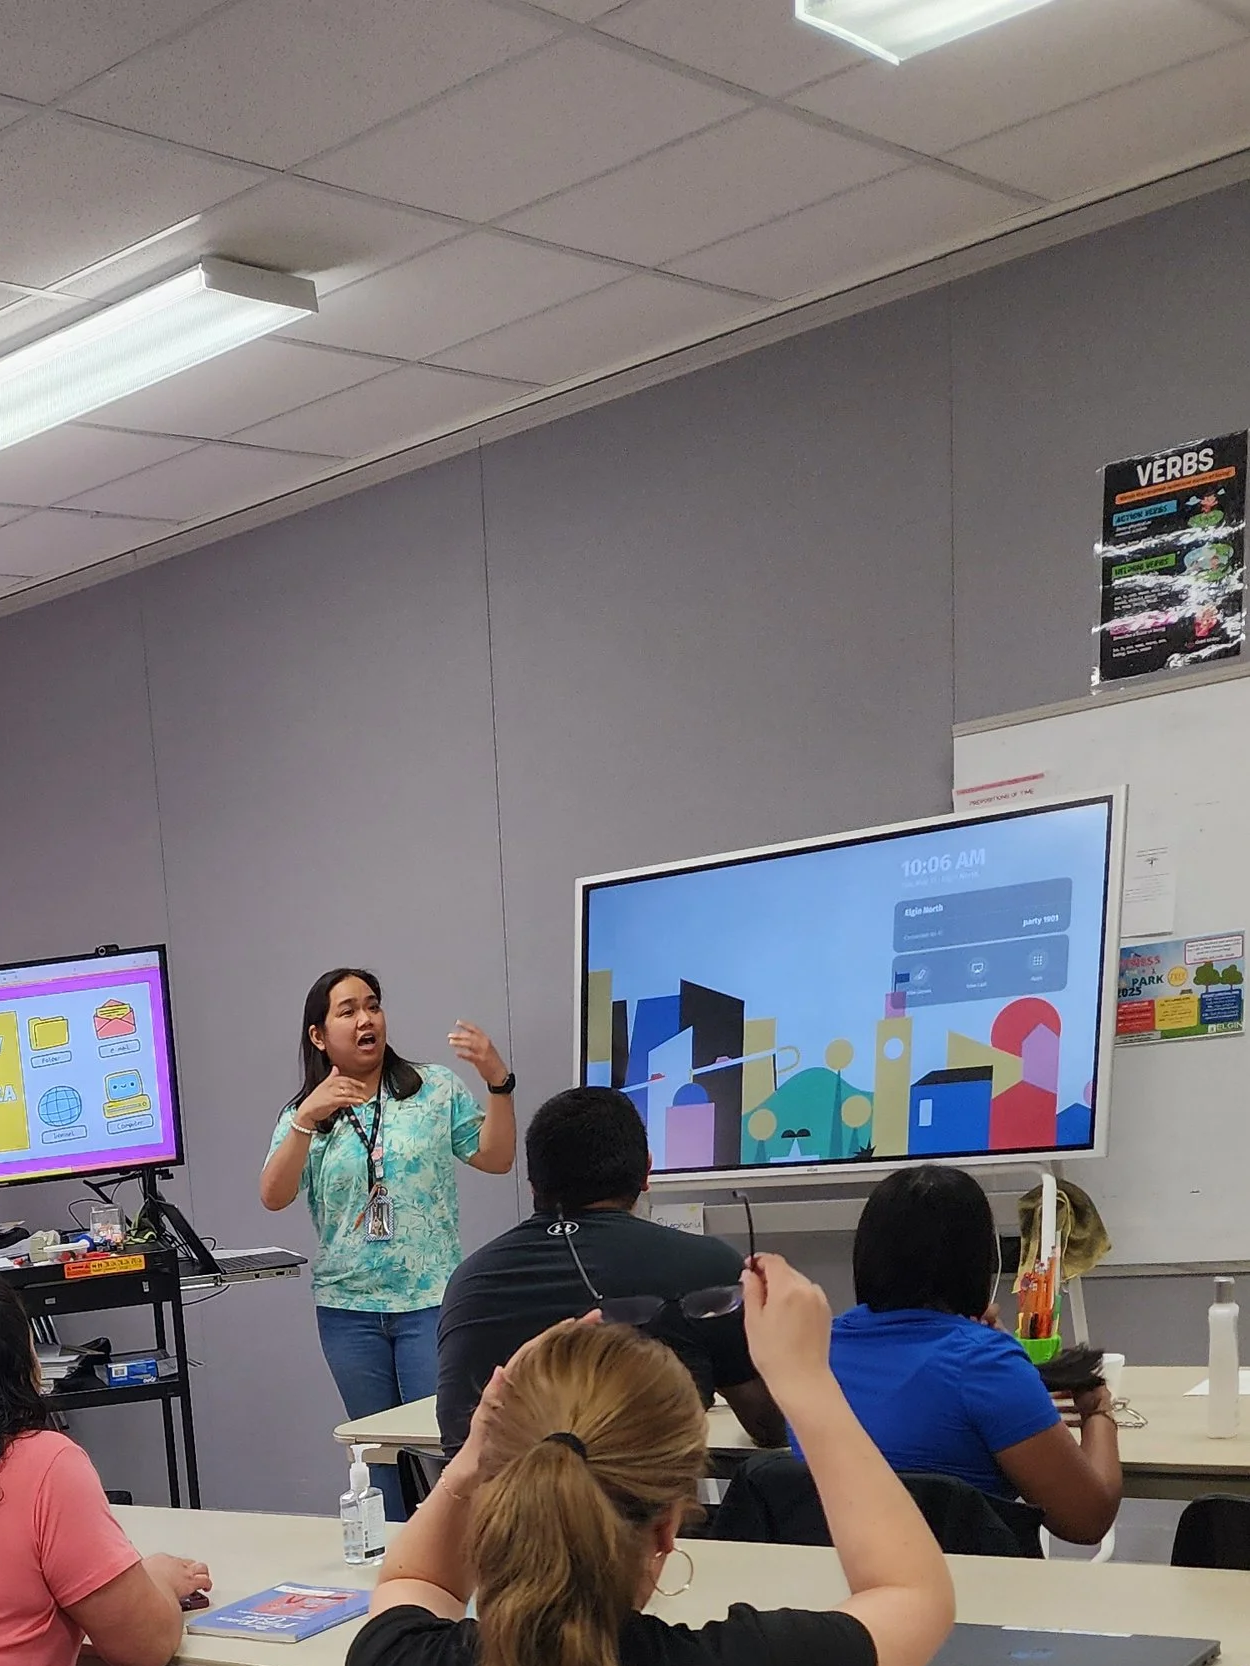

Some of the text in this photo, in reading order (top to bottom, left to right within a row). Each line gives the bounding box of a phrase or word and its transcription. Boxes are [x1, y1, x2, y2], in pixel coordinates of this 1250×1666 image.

[1136, 447, 1215, 487] VERBS
[901, 848, 985, 877] 10:06 AM
[904, 907, 923, 917] Elgin
[1132, 975, 1165, 987] PARK
[1216, 1022, 1243, 1031] ELGIN
